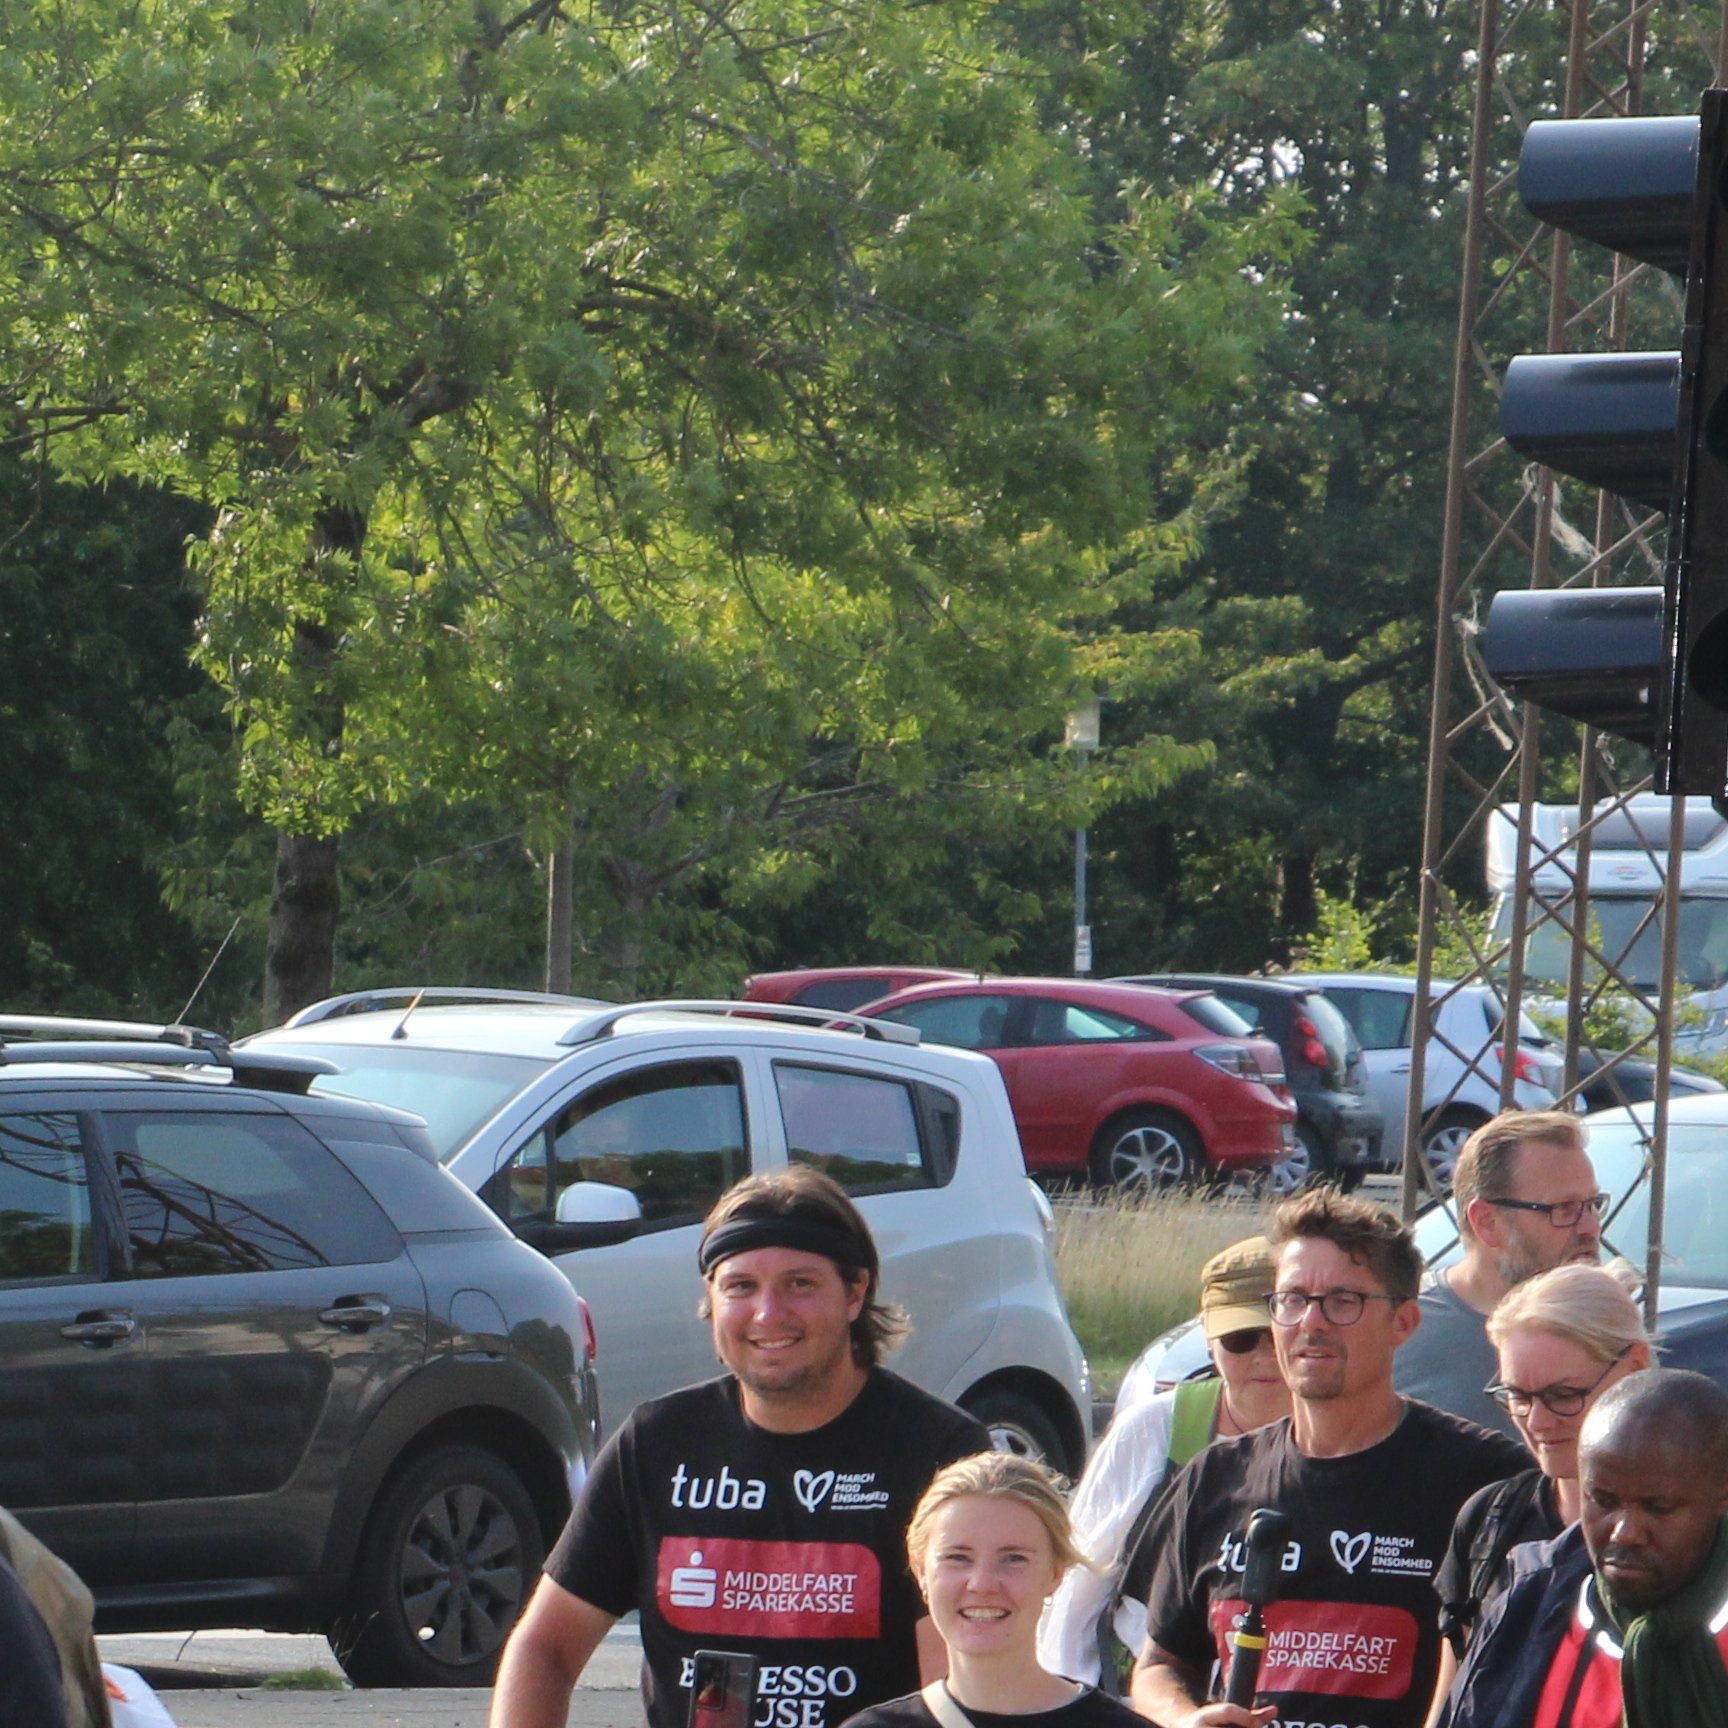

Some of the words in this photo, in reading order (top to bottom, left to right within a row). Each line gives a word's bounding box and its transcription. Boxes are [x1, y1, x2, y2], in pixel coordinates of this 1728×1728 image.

[671, 1463, 767, 1510] tuba
[837, 1472, 876, 1483] MARCH
[1217, 1532, 1301, 1573] tua
[1373, 1546, 1400, 1557] MOD
[1375, 1535, 1414, 1548] MARCH
[1371, 1555, 1433, 1570] ENSOMHED
[724, 1570, 857, 1593] MIDDELFART
[722, 1590, 855, 1613] SPAREKASSE
[1269, 1631, 1397, 1656] MIDDELFART
[1265, 1650, 1391, 1674] SPAREKASSE
